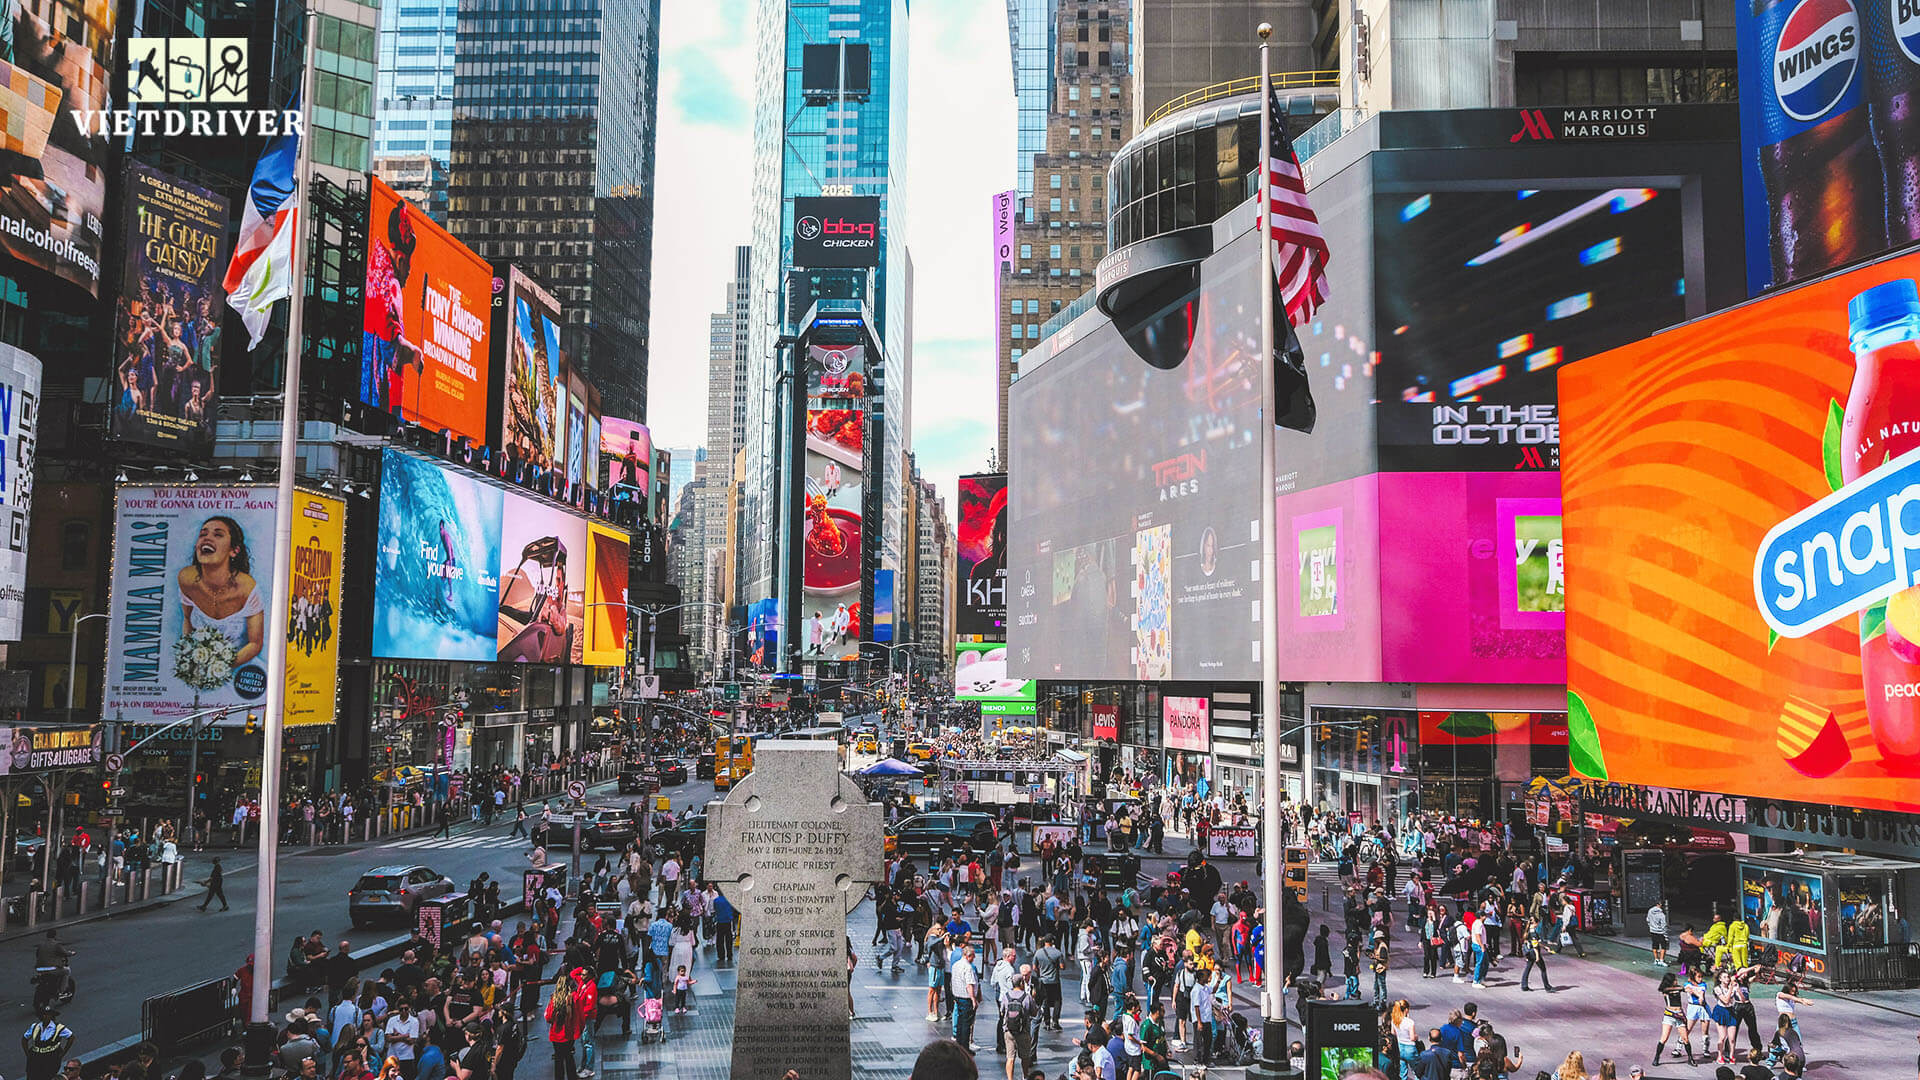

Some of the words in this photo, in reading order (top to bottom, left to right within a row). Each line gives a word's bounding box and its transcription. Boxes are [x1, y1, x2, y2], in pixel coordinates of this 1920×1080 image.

[1779, 26, 1856, 82] WINGS
[1564, 108, 1657, 122] MARRIOTT
[1564, 124, 1647, 137] MARQUIS
[821, 185, 853, 196] 2025
[139, 207, 166, 239] THE
[168, 222, 219, 258] GREAT
[823, 239, 874, 247] CHICKEN
[146, 239, 209, 278] GATSBY
[448, 284, 461, 303] THE
[426, 286, 451, 323] TONY
[452, 301, 486, 343] AWARD-
[433, 317, 472, 362] WINNING
[423, 339, 456, 370] BROADWAY
[455, 356, 478, 383] MUSICAL
[1433, 405, 1468, 424] IN
[1477, 405, 1559, 424] THE
[1854, 437, 1874, 463] ALL
[1152, 449, 1207, 487] TRON
[153, 489, 172, 499] YOU
[174, 489, 217, 499] ALREADY
[221, 489, 250, 499] KNOW
[1159, 479, 1199, 502] ARES
[125, 499, 158, 509] YOU'RE
[161, 500, 195, 509] GONNA
[198, 500, 222, 509] LOVE
[128, 521, 169, 579] MIA!
[420, 539, 438, 561] Find
[427, 561, 446, 580] your
[446, 565, 463, 580] wave
[123, 588, 165, 683] MAMMA
[1169, 714, 1201, 730] PANDORA
[33, 732, 60, 750] GRAND
[1583, 780, 1684, 818] AMERICAN
[749, 821, 798, 830] LIEUTENANT
[801, 821, 842, 830] COLONEL
[1210, 828, 1254, 838] CHICAGO
[741, 832, 792, 844] FRANCIS
[808, 832, 850, 844] DUFFY
[747, 847, 765, 855] MAY
[815, 847, 824, 855] 26
[826, 847, 843, 855] 1932
[754, 861, 798, 870] CATHOLIC
[804, 861, 835, 870] PRIEST
[773, 883, 816, 891] CHAPLAIN
[754, 930, 760, 938] A
[764, 930, 781, 938] LIFE
[785, 930, 796, 938] OF
[800, 930, 835, 938] SERVICE
[750, 948, 770, 956] GOD
[773, 948, 792, 956] AND
[795, 948, 837, 956] COUNTRY
[1334, 1023, 1360, 1031] HOPE
